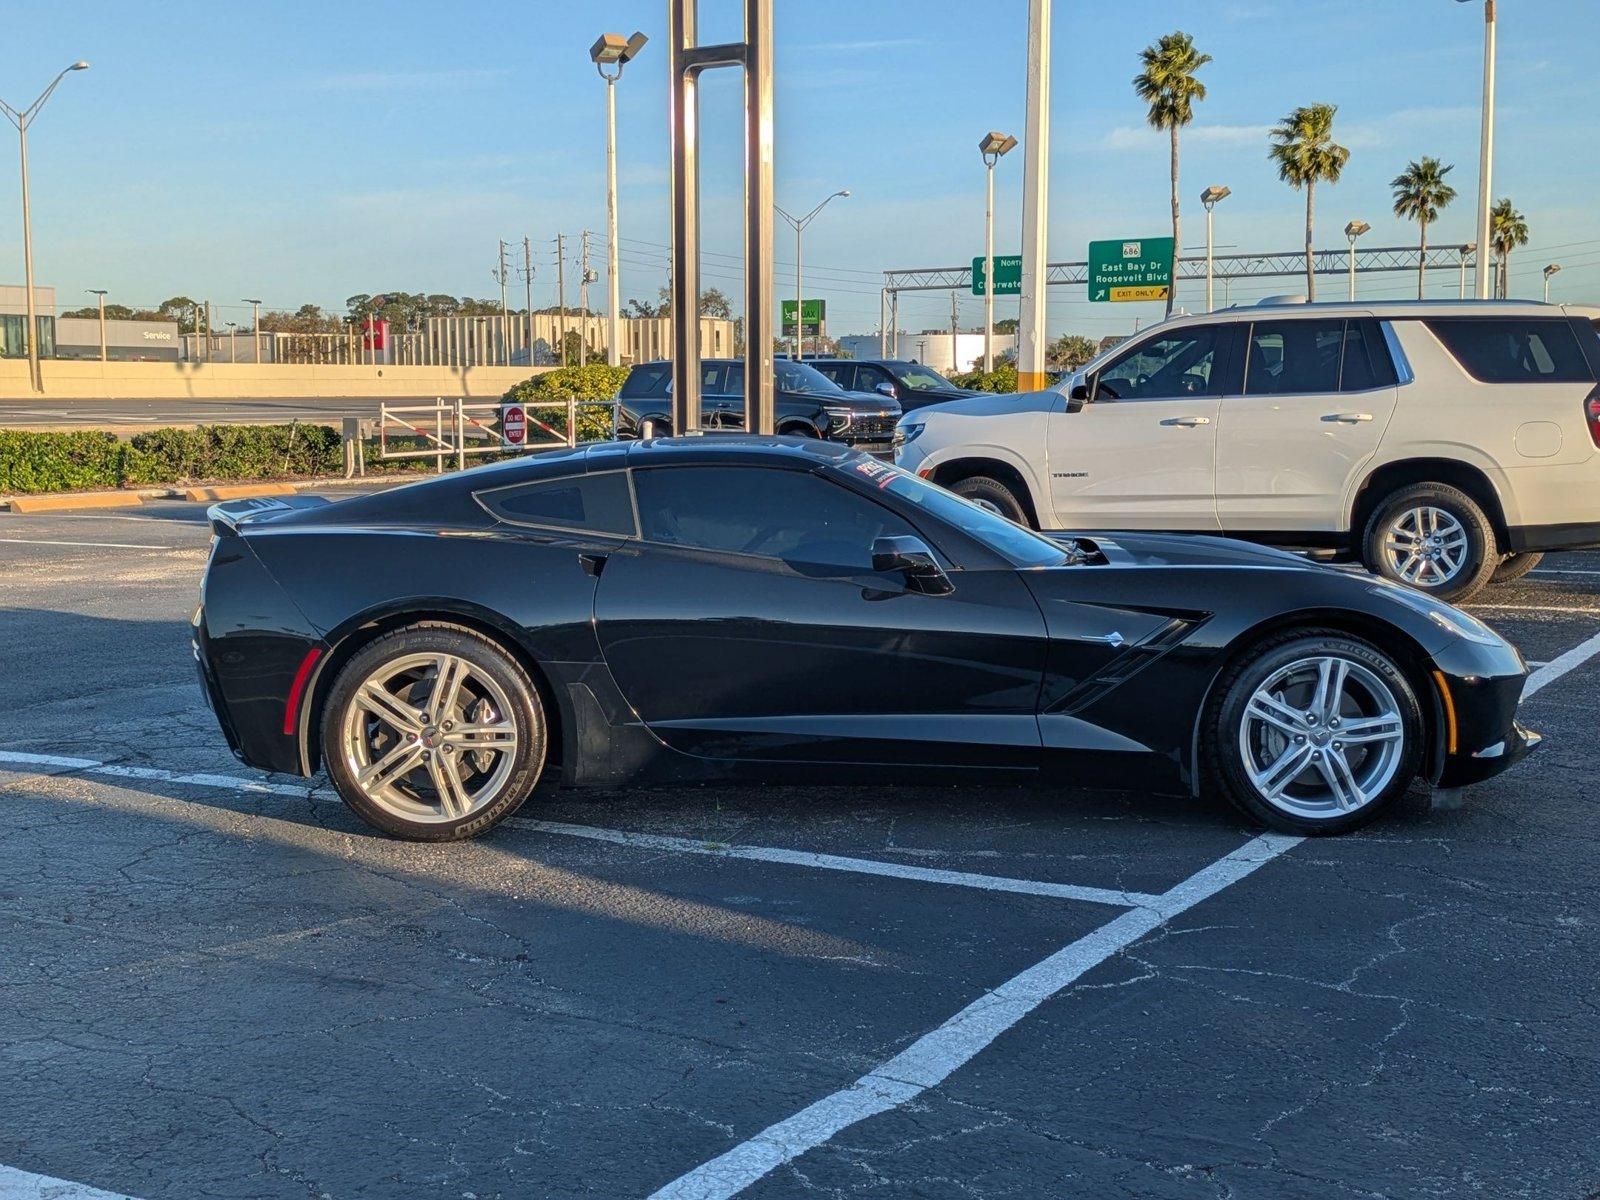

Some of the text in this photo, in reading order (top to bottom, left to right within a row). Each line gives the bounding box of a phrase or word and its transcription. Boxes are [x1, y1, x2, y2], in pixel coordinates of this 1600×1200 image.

[1123, 247, 1139, 256] 686
[1101, 261, 1162, 272] East Bay Dr
[1095, 273, 1168, 283] Roosevelt Blvd
[1117, 289, 1155, 298] EXIT ONLY
[143, 331, 171, 340] Service
[1339, 643, 1394, 674] MICHELIN
[459, 786, 518, 834] MICHELIN
